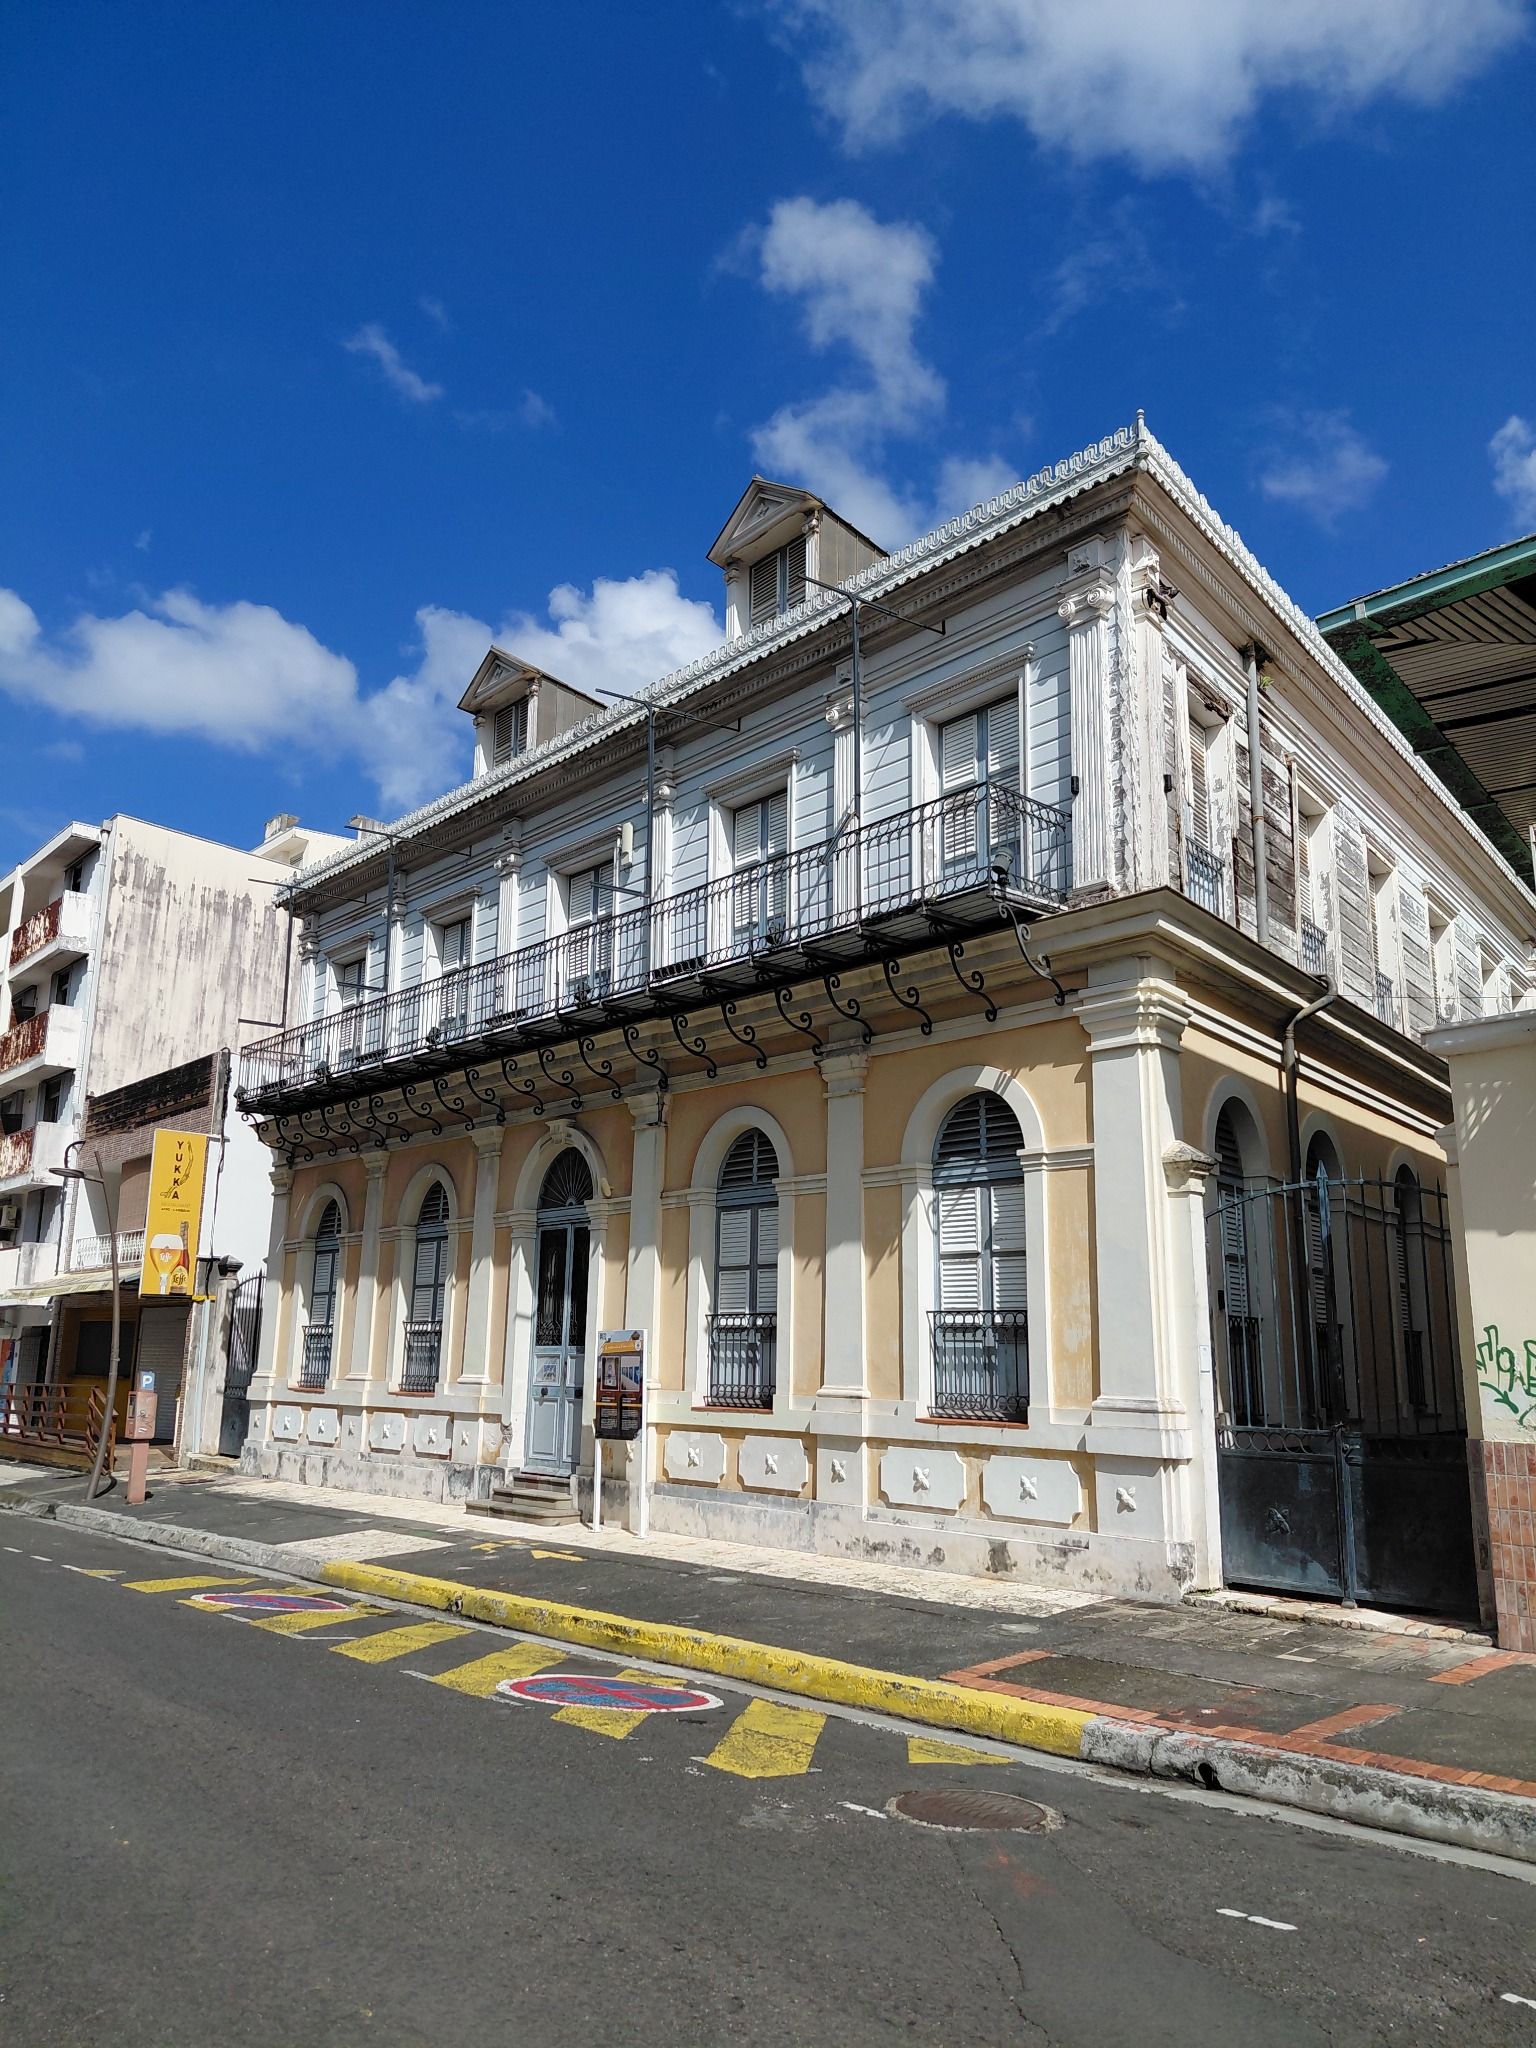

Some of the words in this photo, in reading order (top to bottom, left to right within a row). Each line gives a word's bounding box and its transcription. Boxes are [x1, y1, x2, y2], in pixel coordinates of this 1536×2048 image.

[172, 1140, 184, 1200] YUKKA
[173, 1272, 187, 1286] Leffe
[142, 1375, 153, 1388] P
